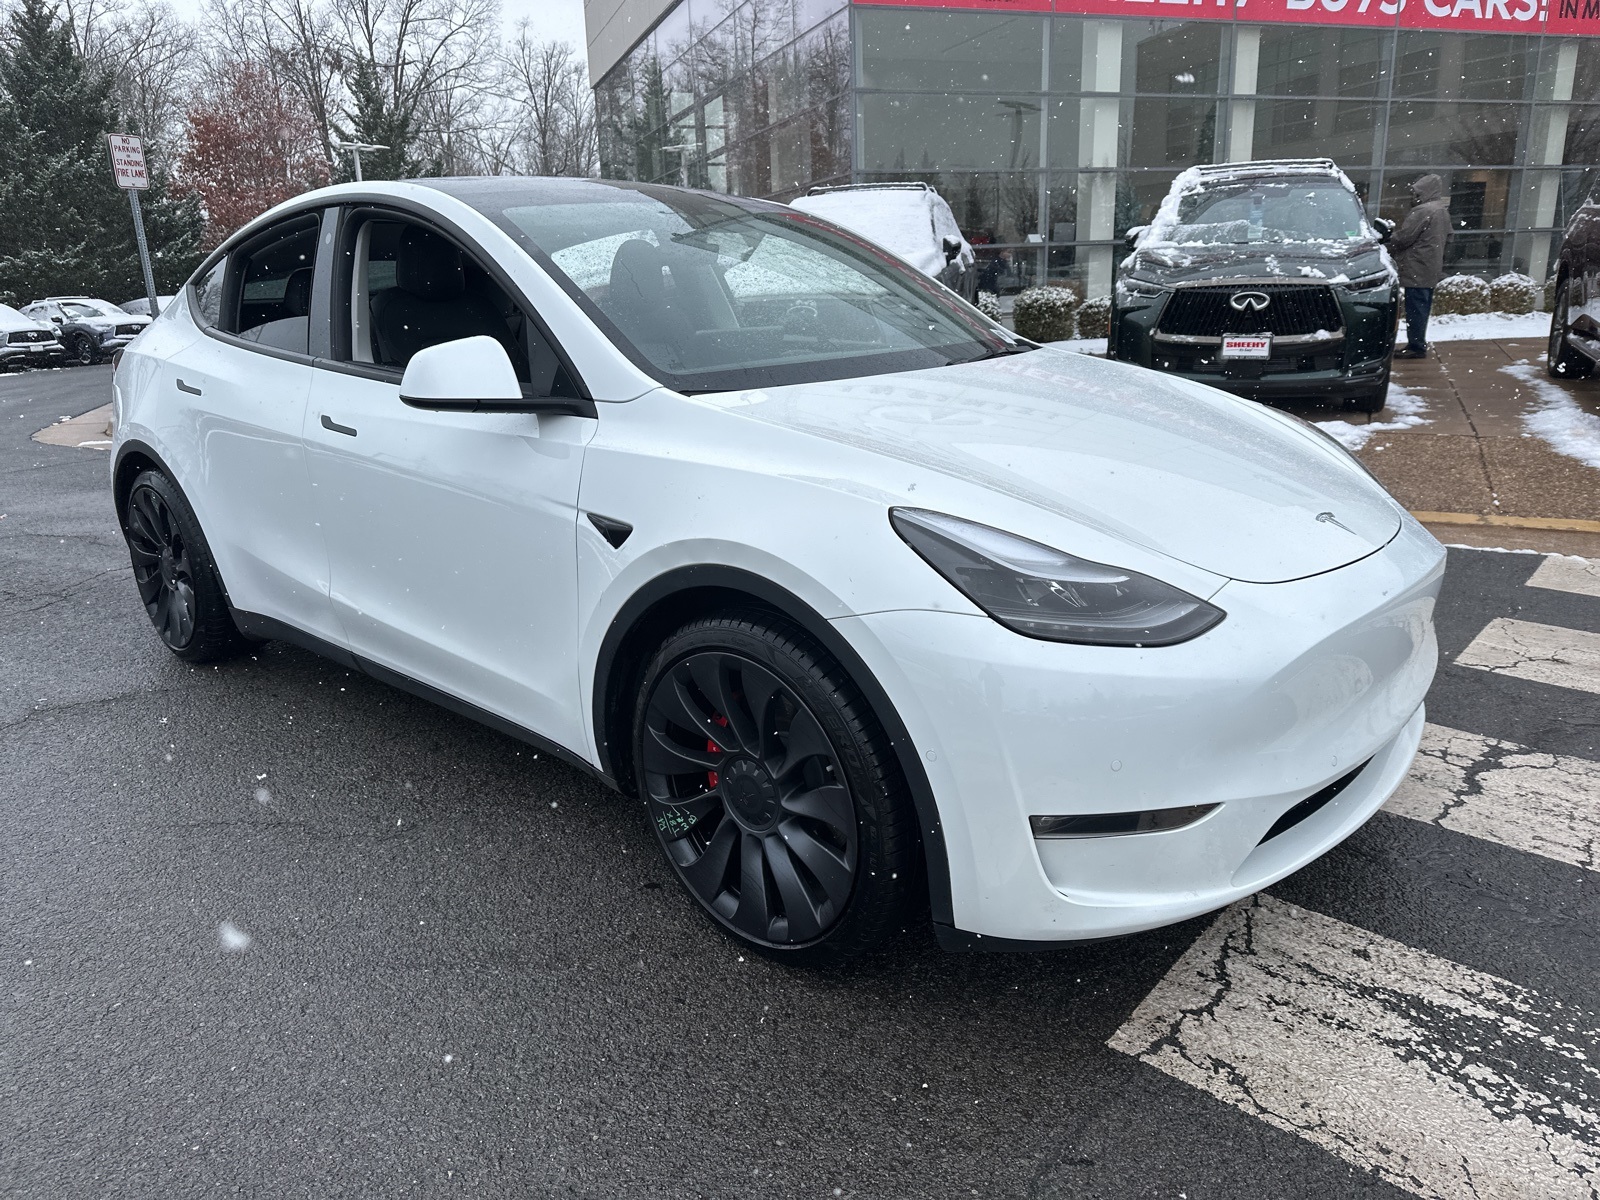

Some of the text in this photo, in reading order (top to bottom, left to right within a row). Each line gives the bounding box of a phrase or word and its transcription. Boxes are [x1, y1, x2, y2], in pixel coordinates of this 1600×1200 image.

[121, 137, 130, 145] NO
[114, 145, 140, 154] PARKING
[116, 159, 143, 167] STANDING
[117, 168, 146, 178] FIRE LANE
